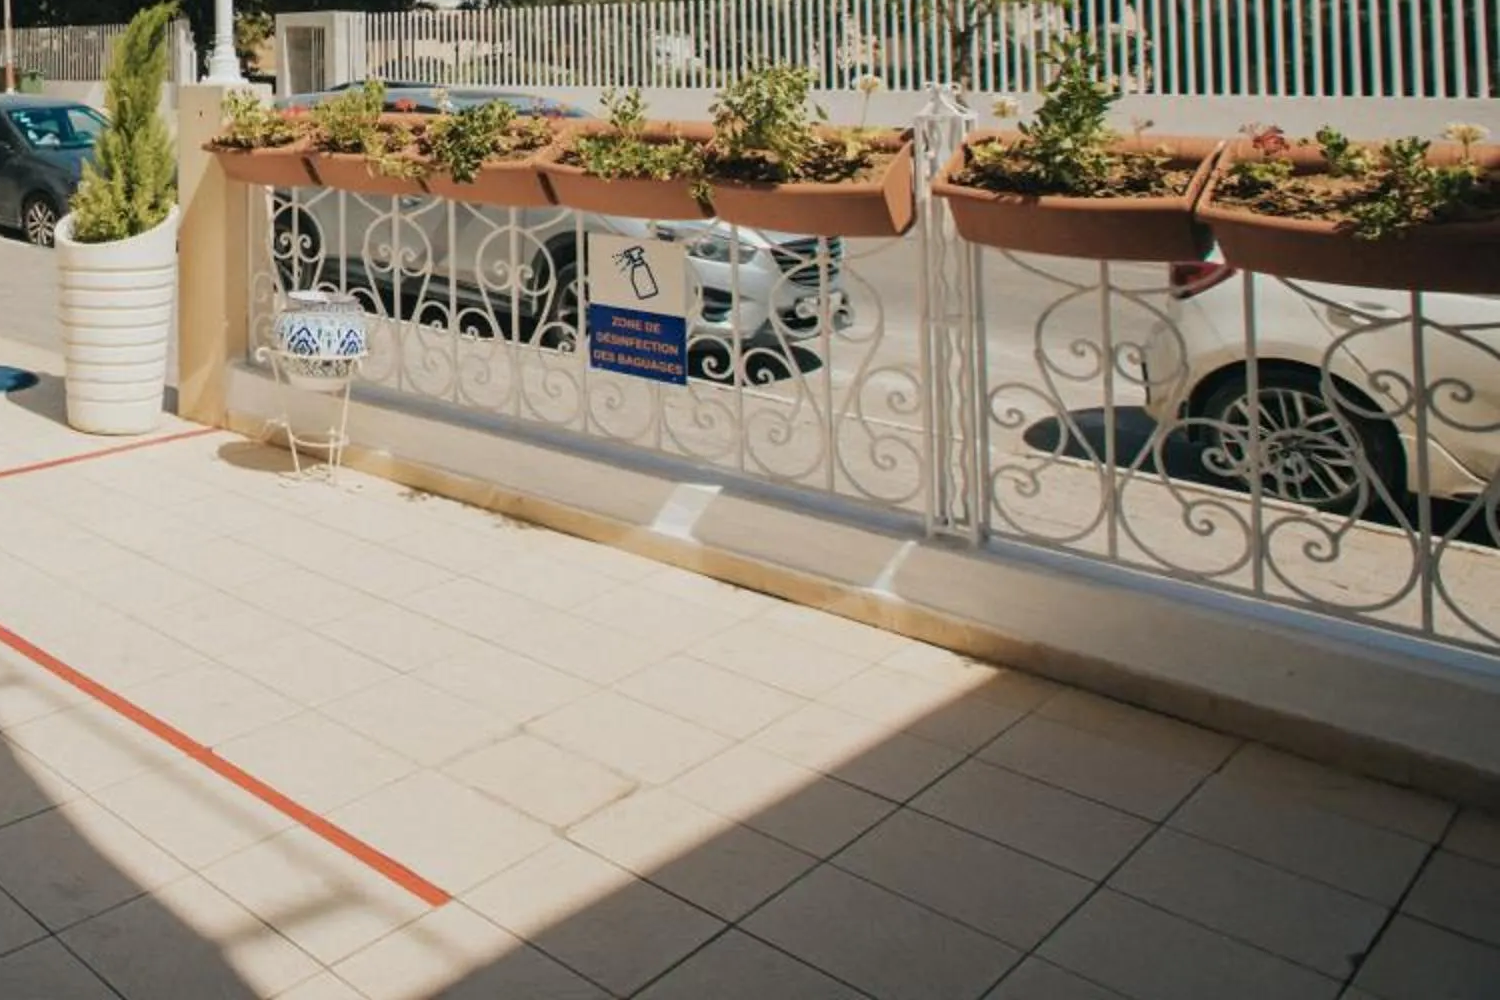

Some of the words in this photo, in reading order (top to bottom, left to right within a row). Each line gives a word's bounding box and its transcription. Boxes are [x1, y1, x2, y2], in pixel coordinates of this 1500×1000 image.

[612, 316, 643, 331] ZONE
[644, 322, 660, 335] DE
[594, 349, 615, 362] DES
